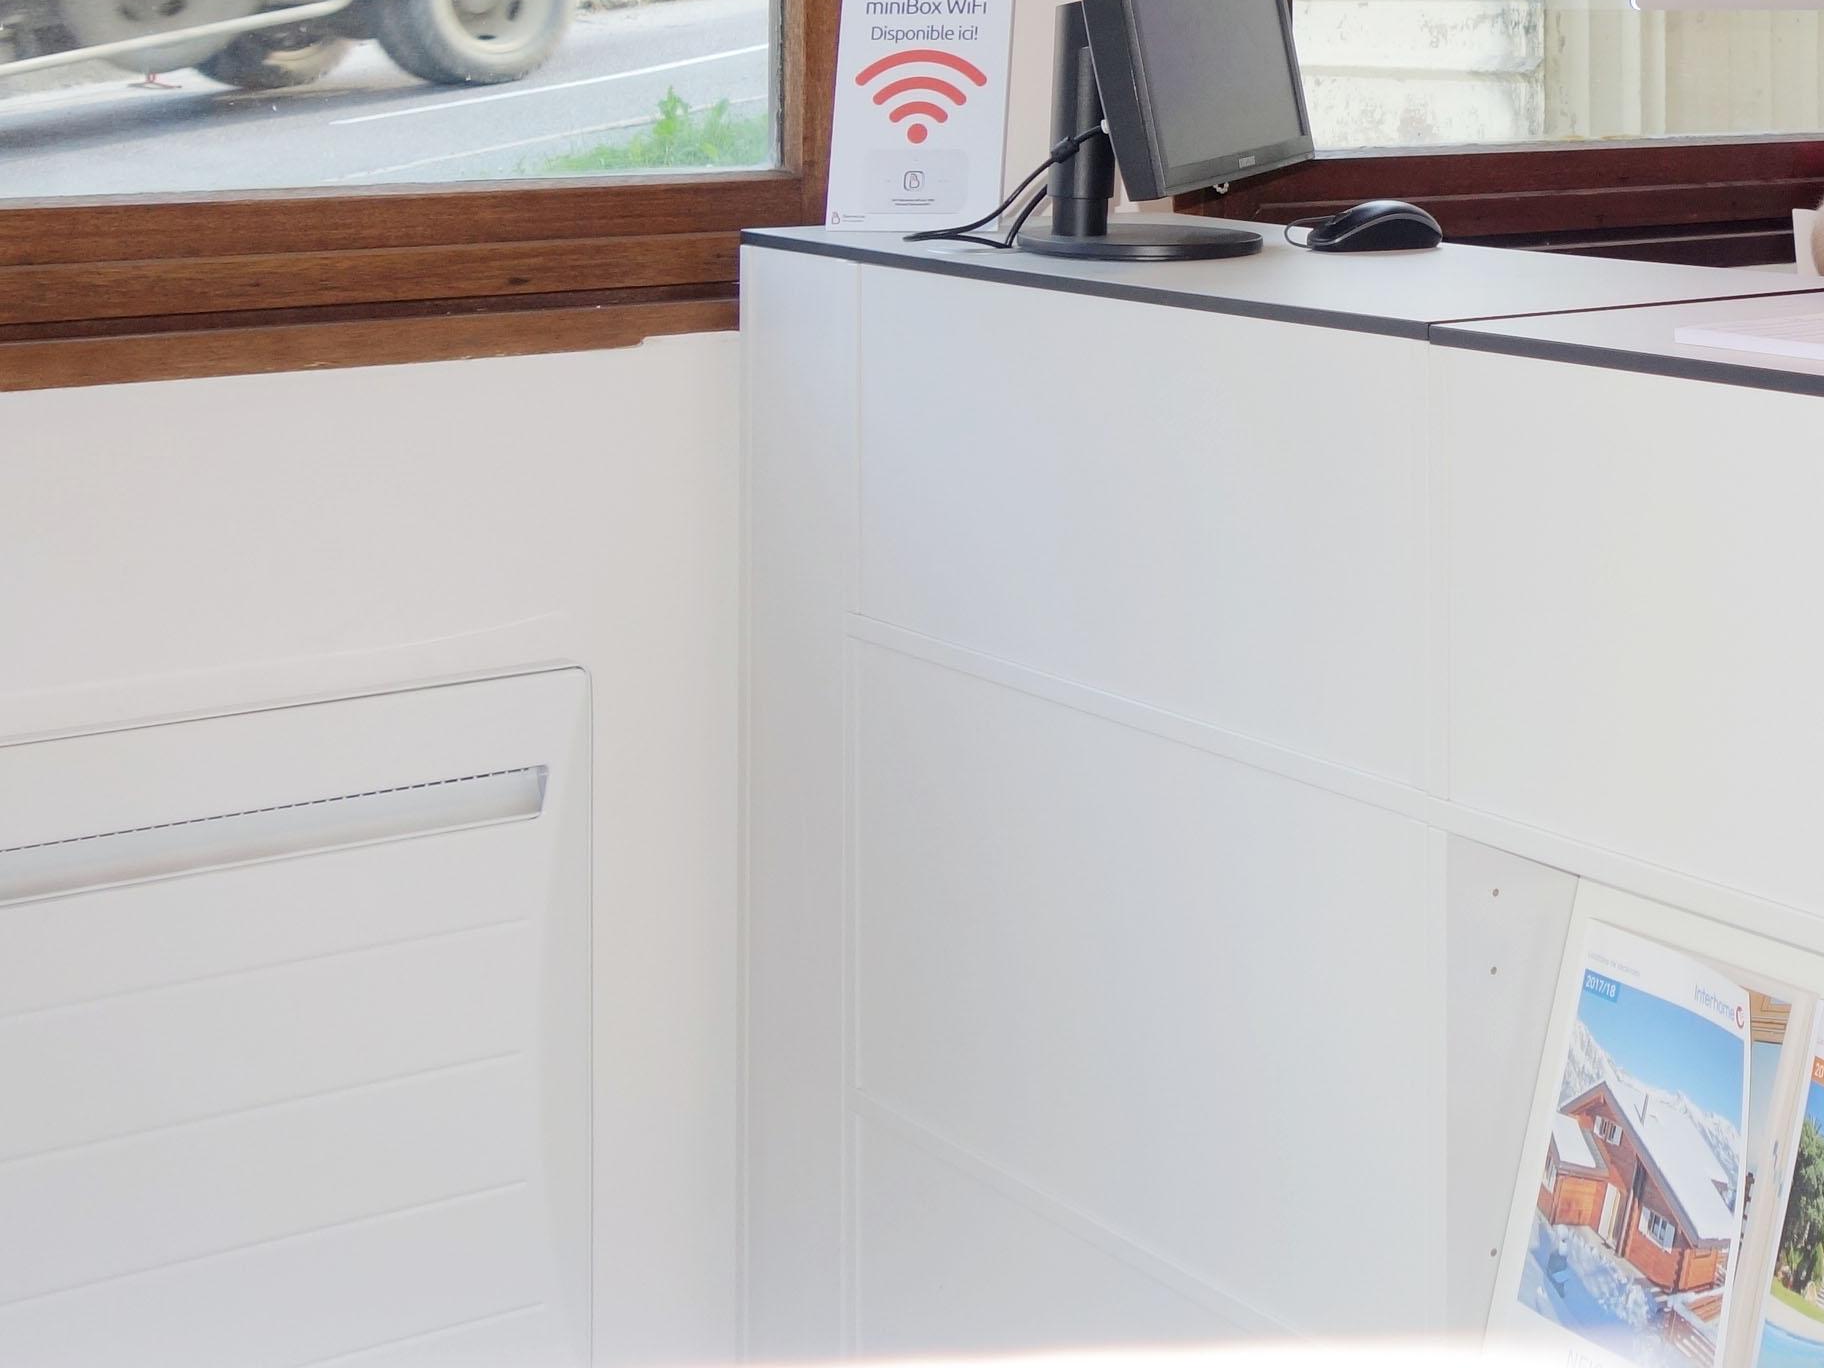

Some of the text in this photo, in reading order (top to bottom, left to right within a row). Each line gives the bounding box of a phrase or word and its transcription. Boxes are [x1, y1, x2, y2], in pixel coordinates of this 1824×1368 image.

[871, 25, 979, 44] Disponible ici!
[1585, 974, 1617, 998] 2017/18
[1694, 984, 1735, 1021] Interhome
